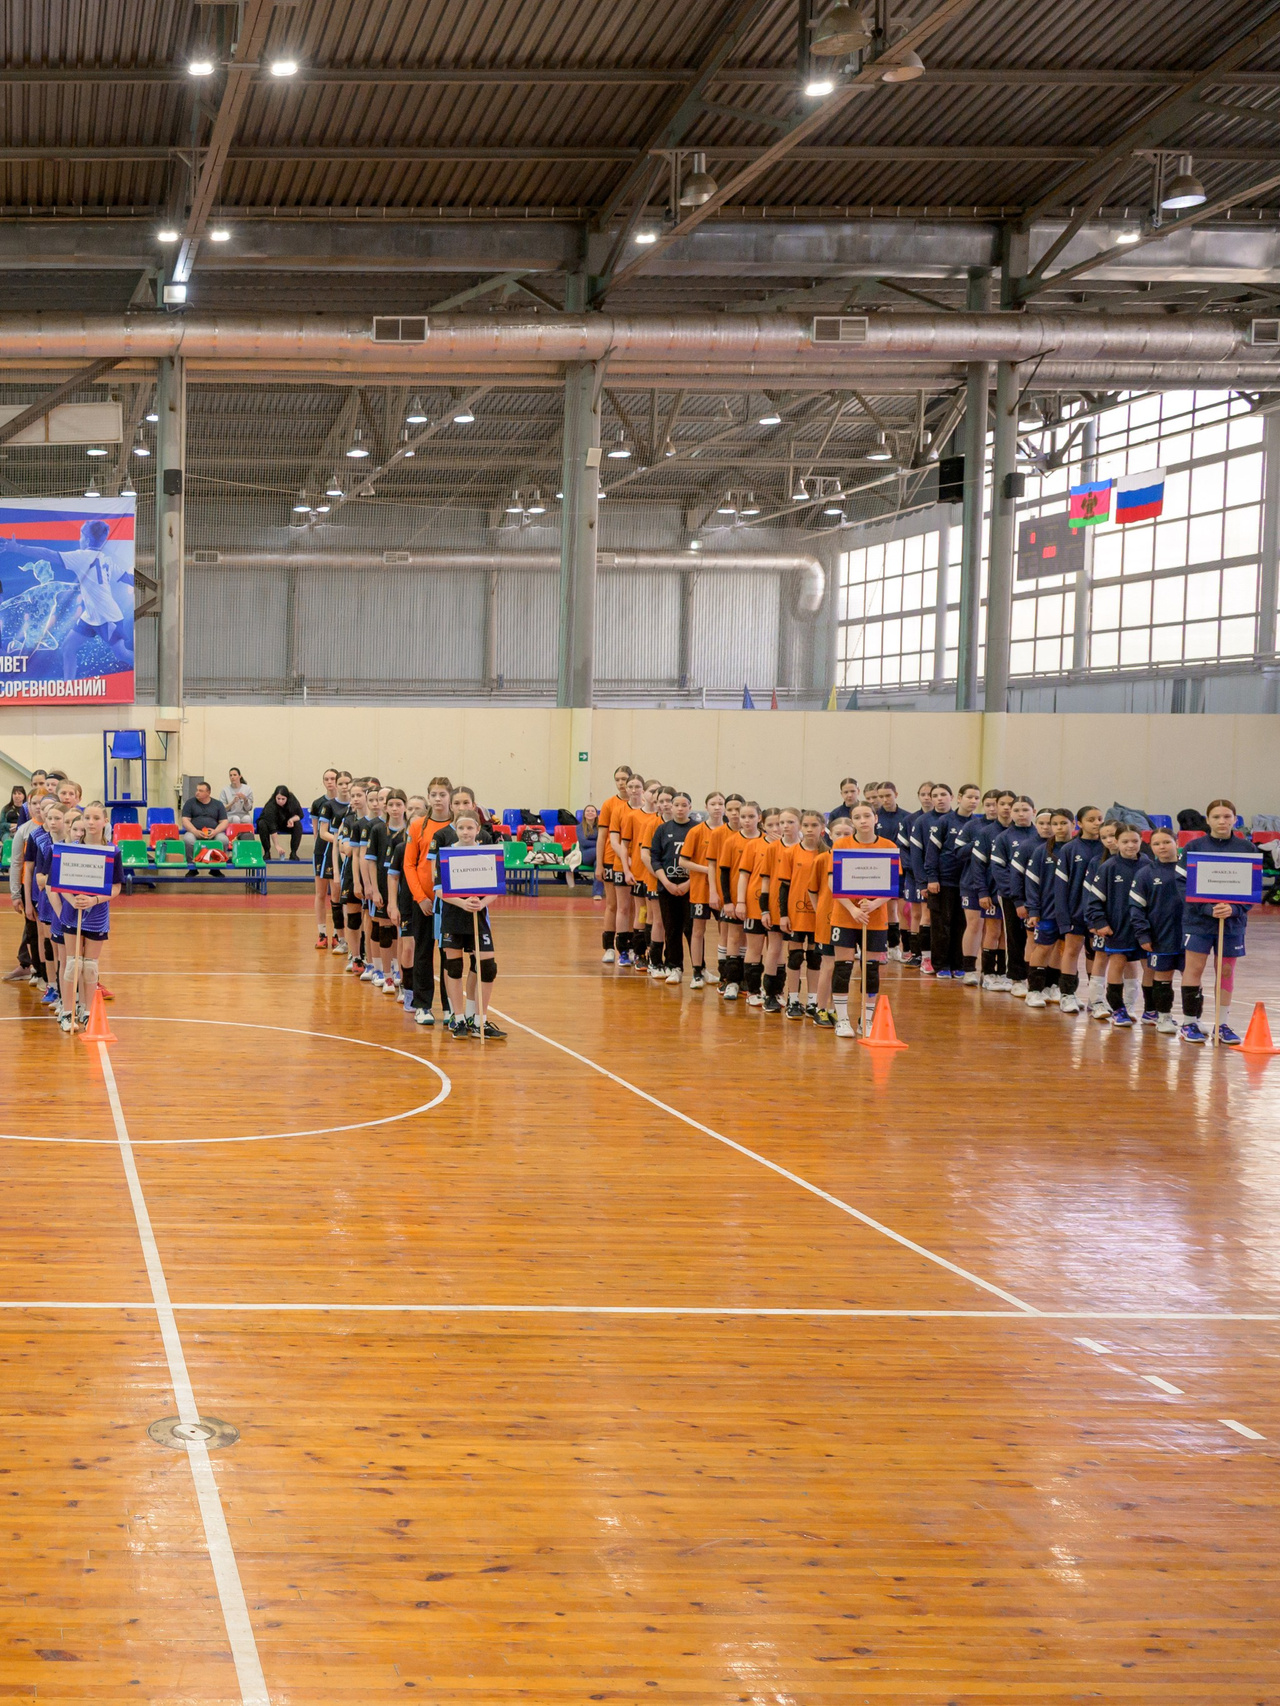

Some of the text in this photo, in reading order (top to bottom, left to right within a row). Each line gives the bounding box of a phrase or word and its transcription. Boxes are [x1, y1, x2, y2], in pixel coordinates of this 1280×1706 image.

[614, 872, 623, 883] 15
[694, 903, 703, 915] 18
[482, 933, 491, 945] 5
[831, 927, 840, 942] 8
[1184, 933, 1191, 946] 7
